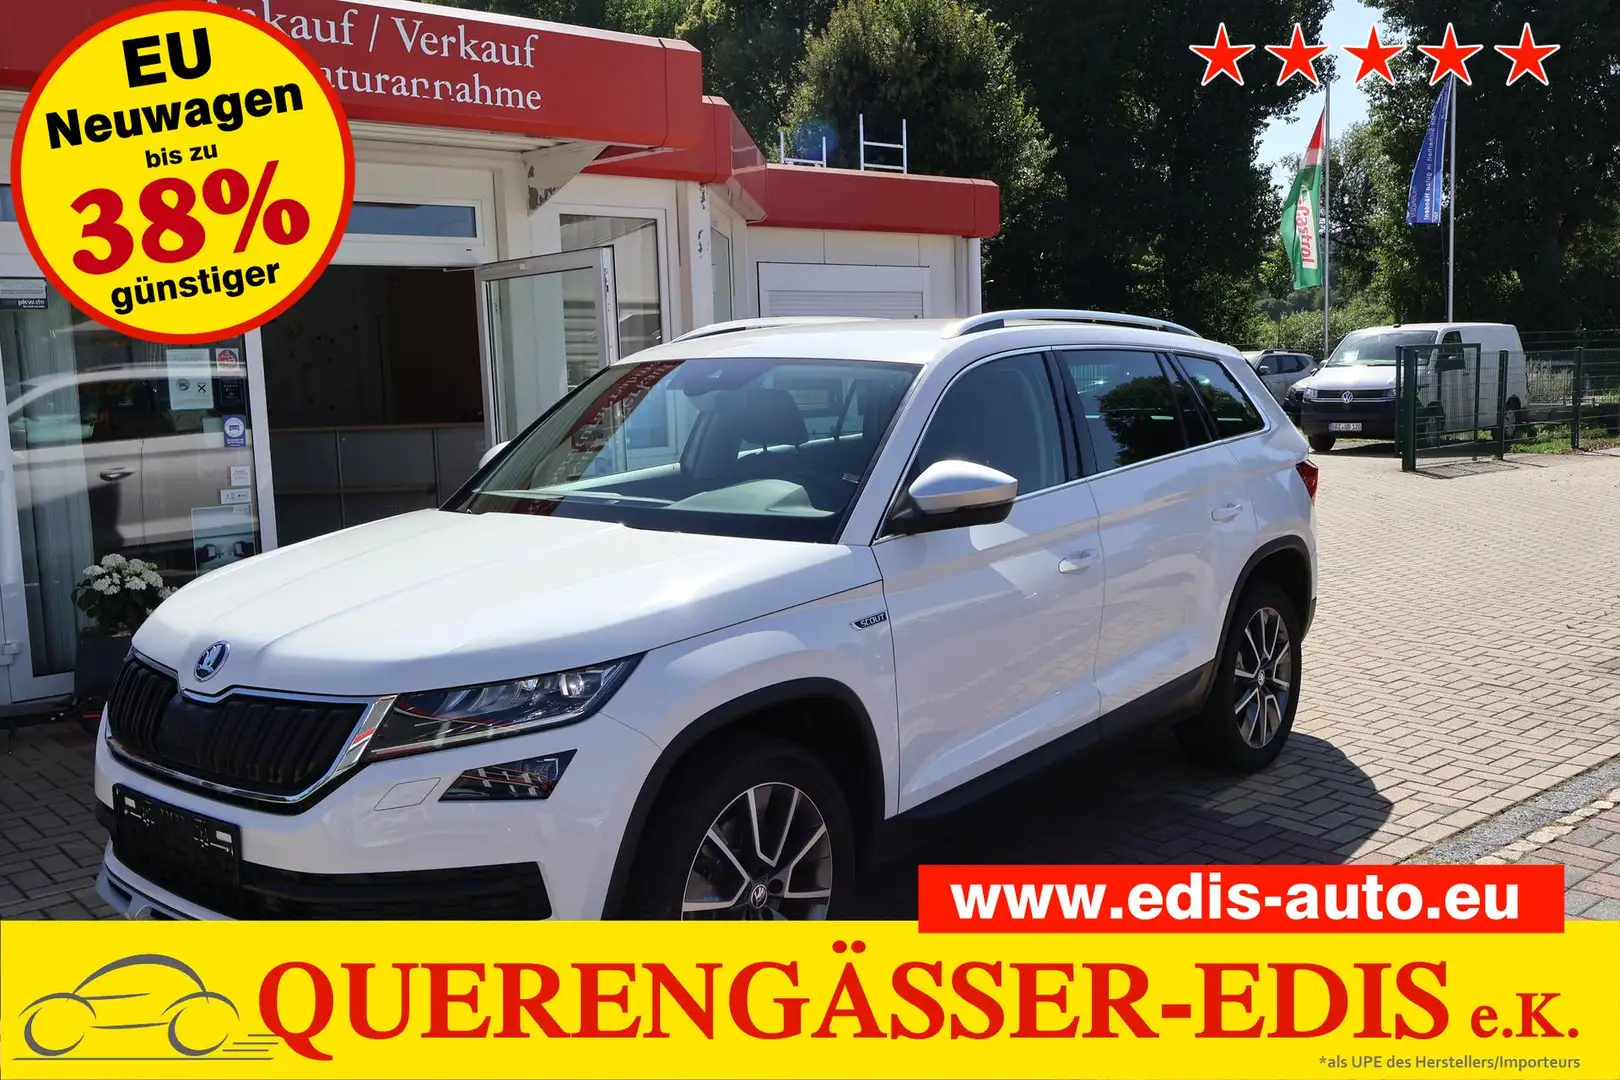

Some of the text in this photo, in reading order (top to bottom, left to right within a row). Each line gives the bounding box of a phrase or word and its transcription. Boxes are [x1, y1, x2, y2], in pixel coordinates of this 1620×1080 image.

[391, 16, 539, 68] Verkauf
[1296, 205, 1316, 264] Castrol
[17, 299, 46, 307] pkw.de
[860, 613, 885, 627] SCOUT
